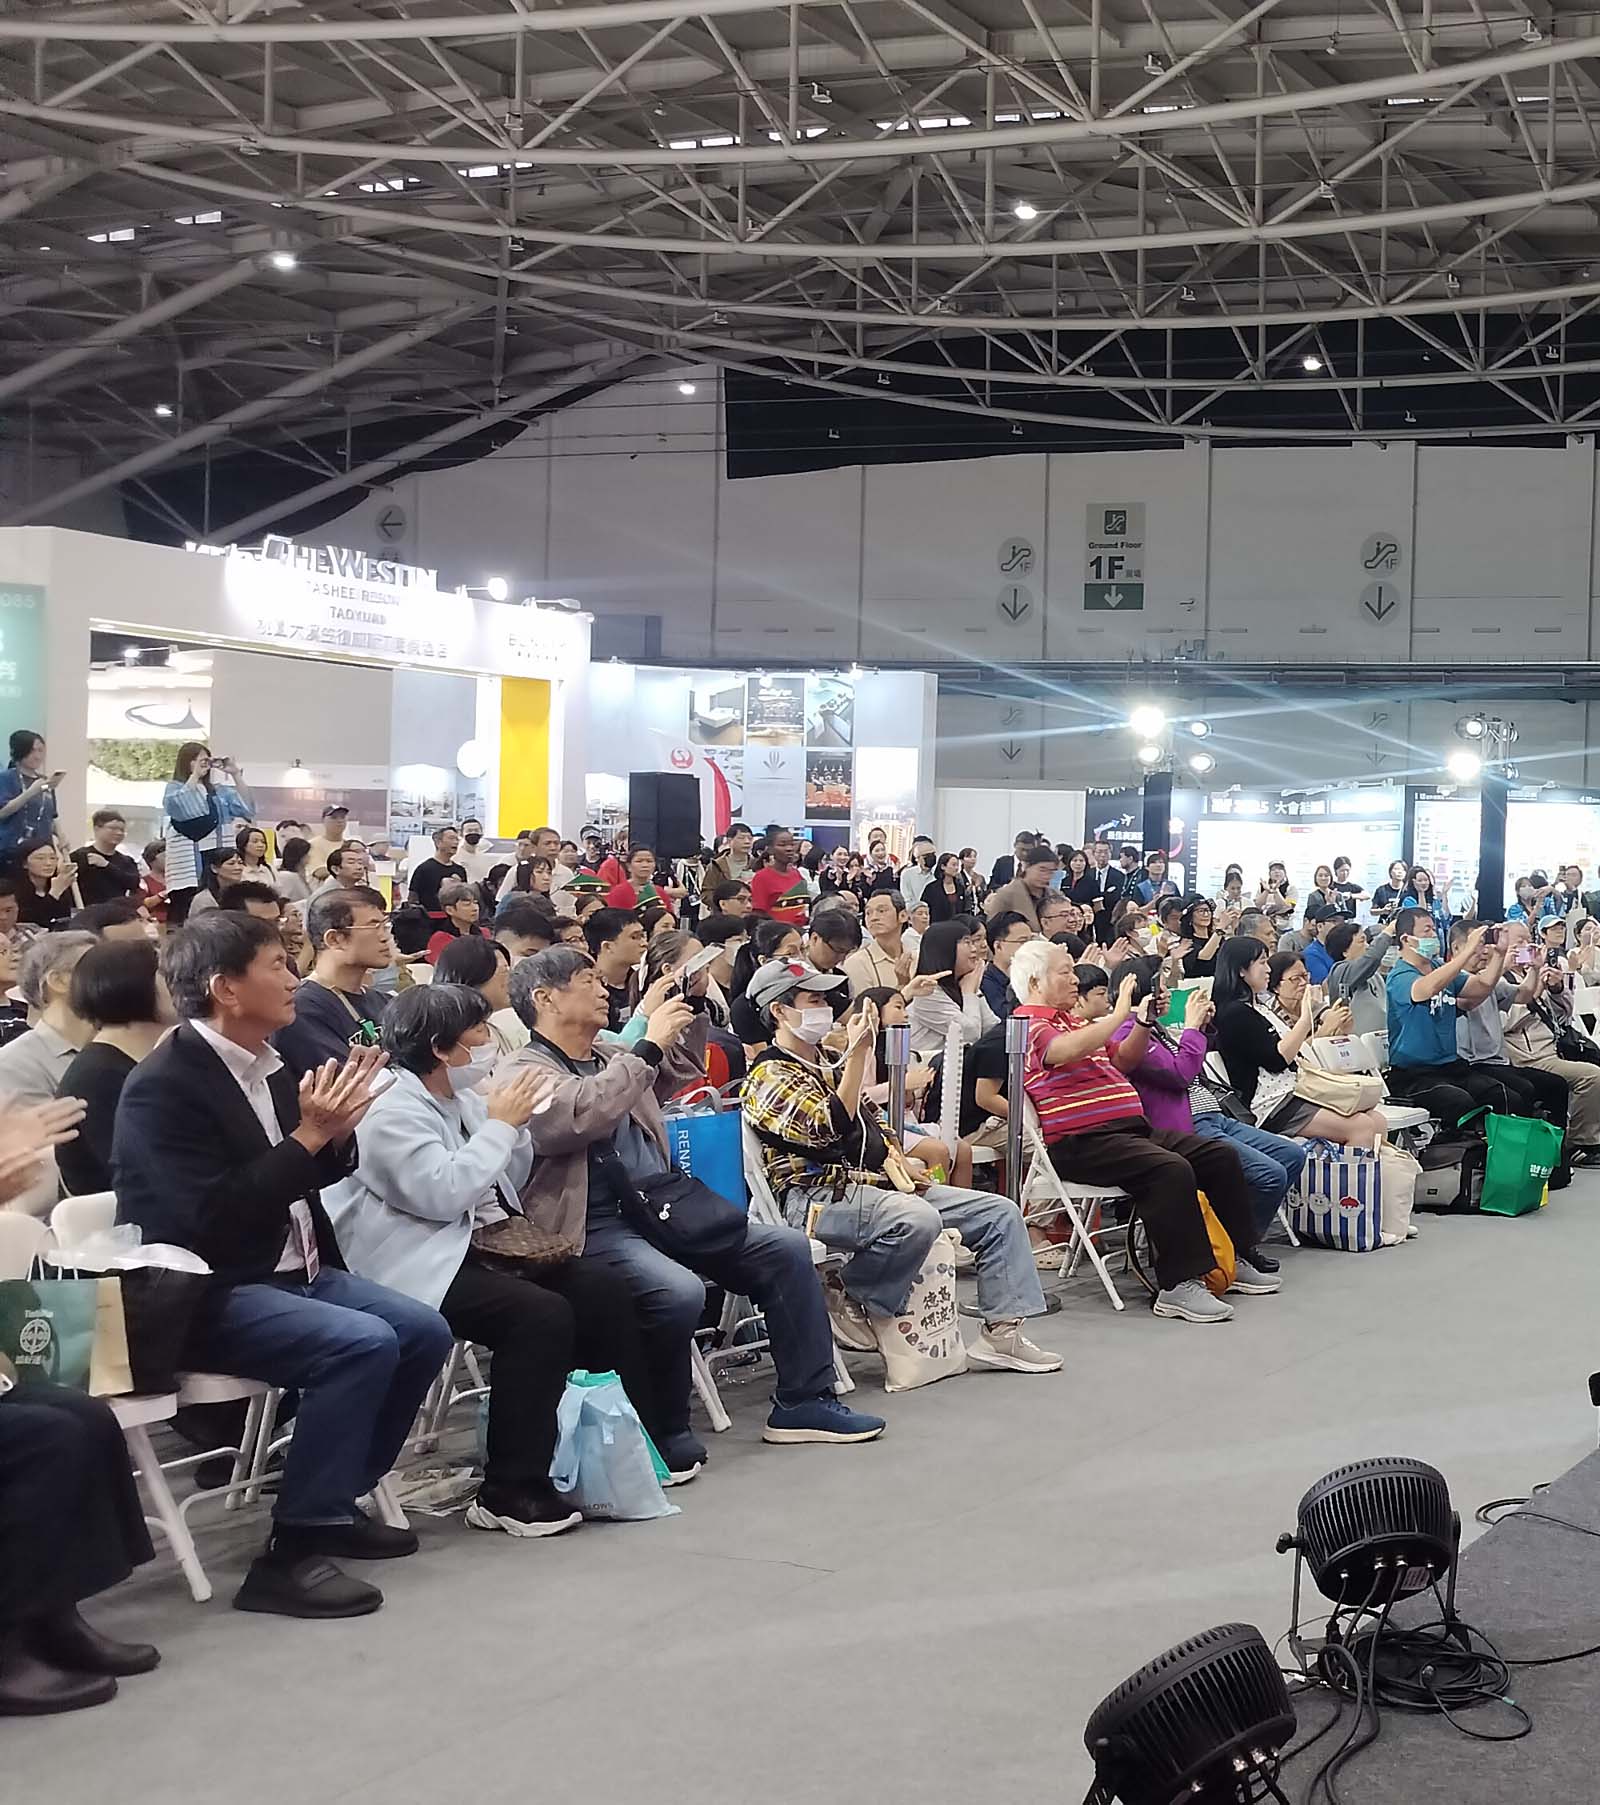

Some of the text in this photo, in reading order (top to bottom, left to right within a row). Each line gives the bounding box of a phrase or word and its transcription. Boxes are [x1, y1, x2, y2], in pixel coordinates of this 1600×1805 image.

[1088, 541, 1144, 550] Ground Floor
[1019, 562, 1032, 573] 1F
[1089, 556, 1125, 580] 1F
[1385, 558, 1398, 569] 1F
